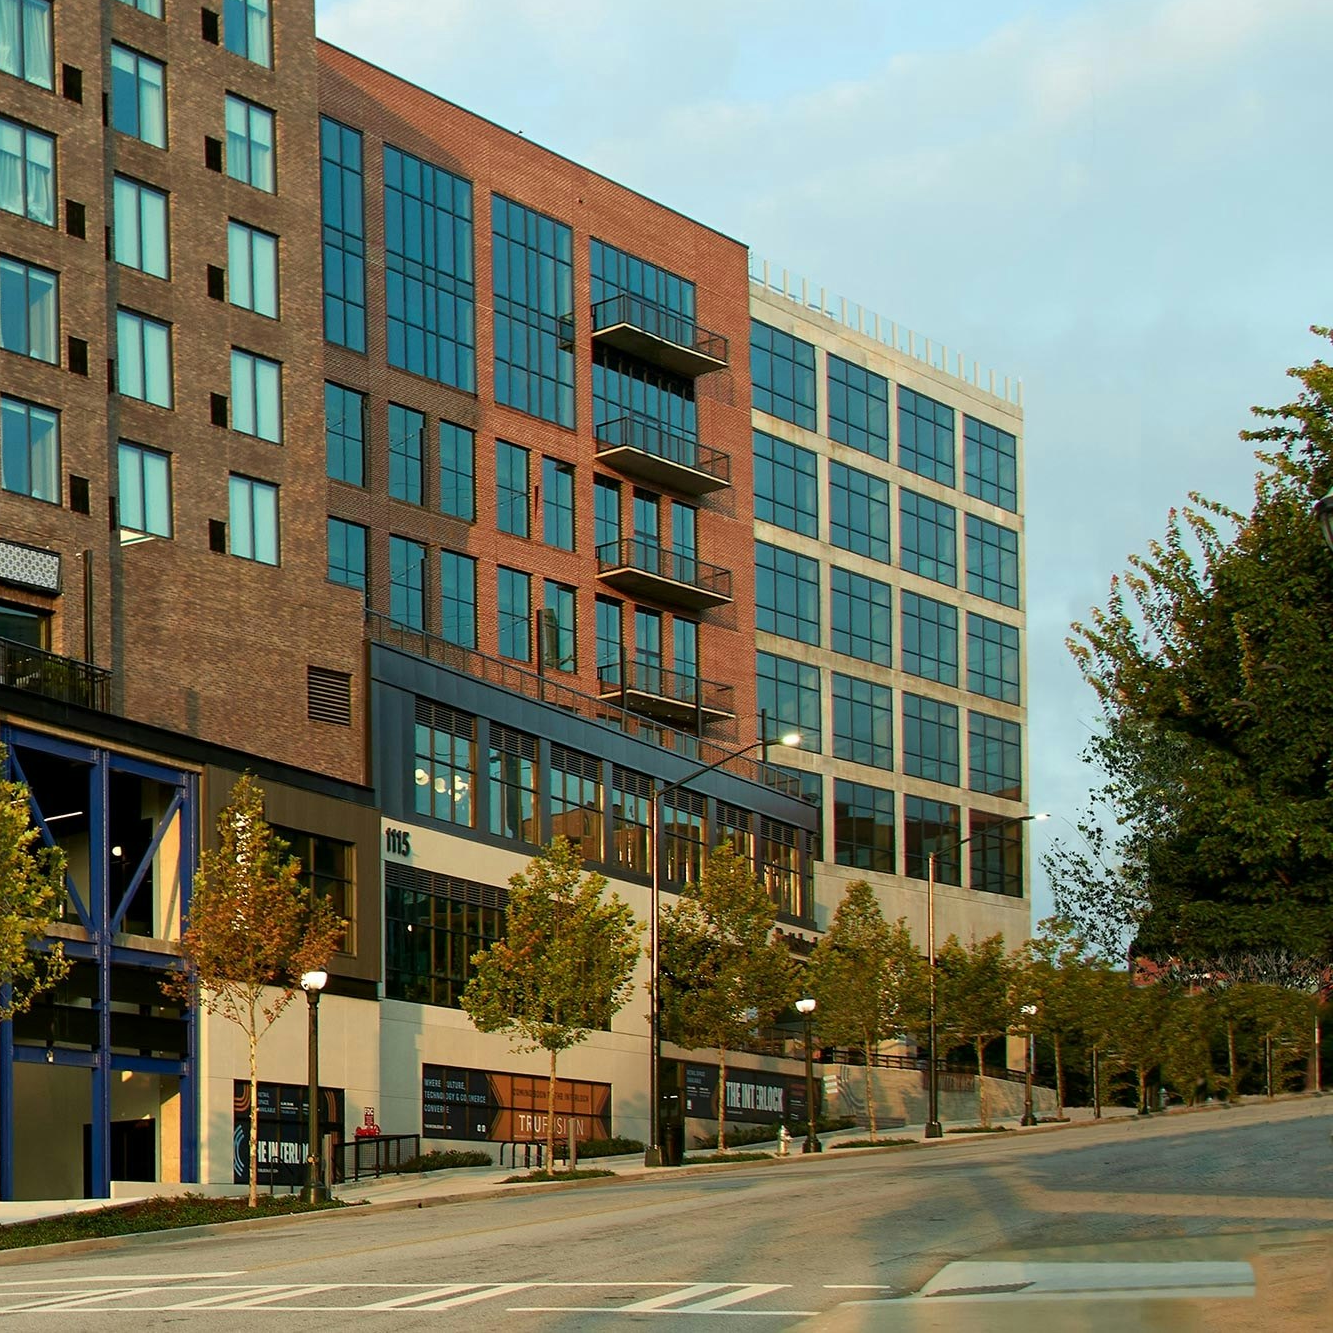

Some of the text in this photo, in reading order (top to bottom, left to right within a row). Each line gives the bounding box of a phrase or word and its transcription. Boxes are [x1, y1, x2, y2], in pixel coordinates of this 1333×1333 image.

[385, 827, 411, 857] 1115
[424, 1090, 455, 1101] TECHNOOGY
[446, 1080, 465, 1090] ULTURE,
[726, 1081, 741, 1107] THE
[742, 1083, 783, 1112] INTERLOCK
[424, 1103, 450, 1114] CONVERE
[519, 1114, 584, 1136] TRUFSIN
[268, 1140, 310, 1164] INTERL
